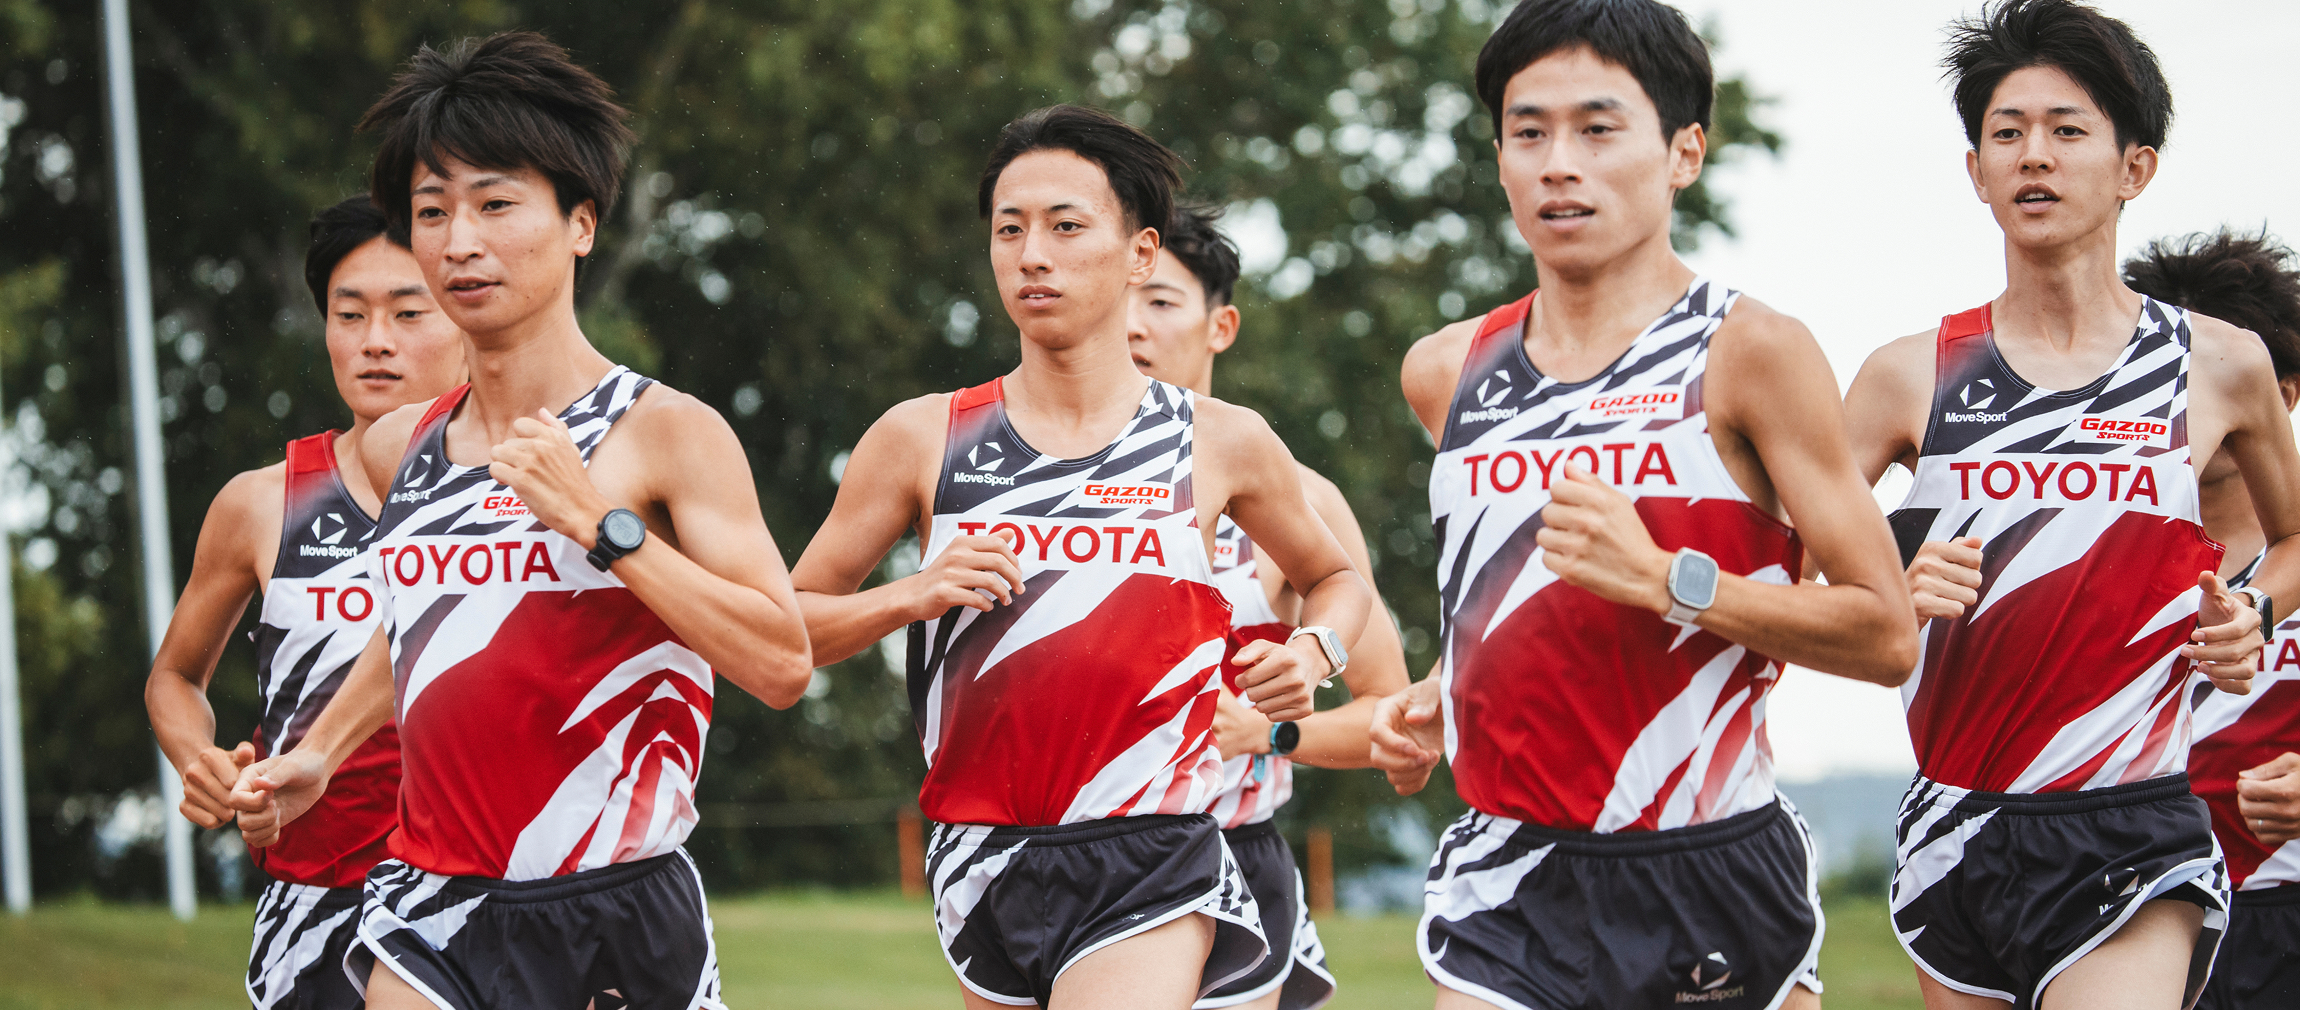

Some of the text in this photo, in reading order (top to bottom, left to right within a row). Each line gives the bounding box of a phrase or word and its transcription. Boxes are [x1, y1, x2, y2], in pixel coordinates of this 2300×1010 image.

[1589, 393, 1678, 410] GAZOO
[1460, 406, 1519, 425] MoveSport
[1603, 407, 1658, 417] SPORTS
[1945, 411, 2007, 425] MoveSport
[2080, 418, 2167, 435] GAZOO
[2096, 432, 2150, 441] SPORTS
[1463, 442, 1678, 496] TOYOTA
[954, 472, 1015, 486] MoveSport
[1949, 460, 2159, 507] TOYOTA
[1084, 484, 1170, 499] GAZOO
[1100, 497, 1154, 505] SPORTS
[300, 544, 358, 559] MoveSport
[379, 541, 562, 587] TOYOTA
[1674, 985, 1744, 1004] MoveSport
